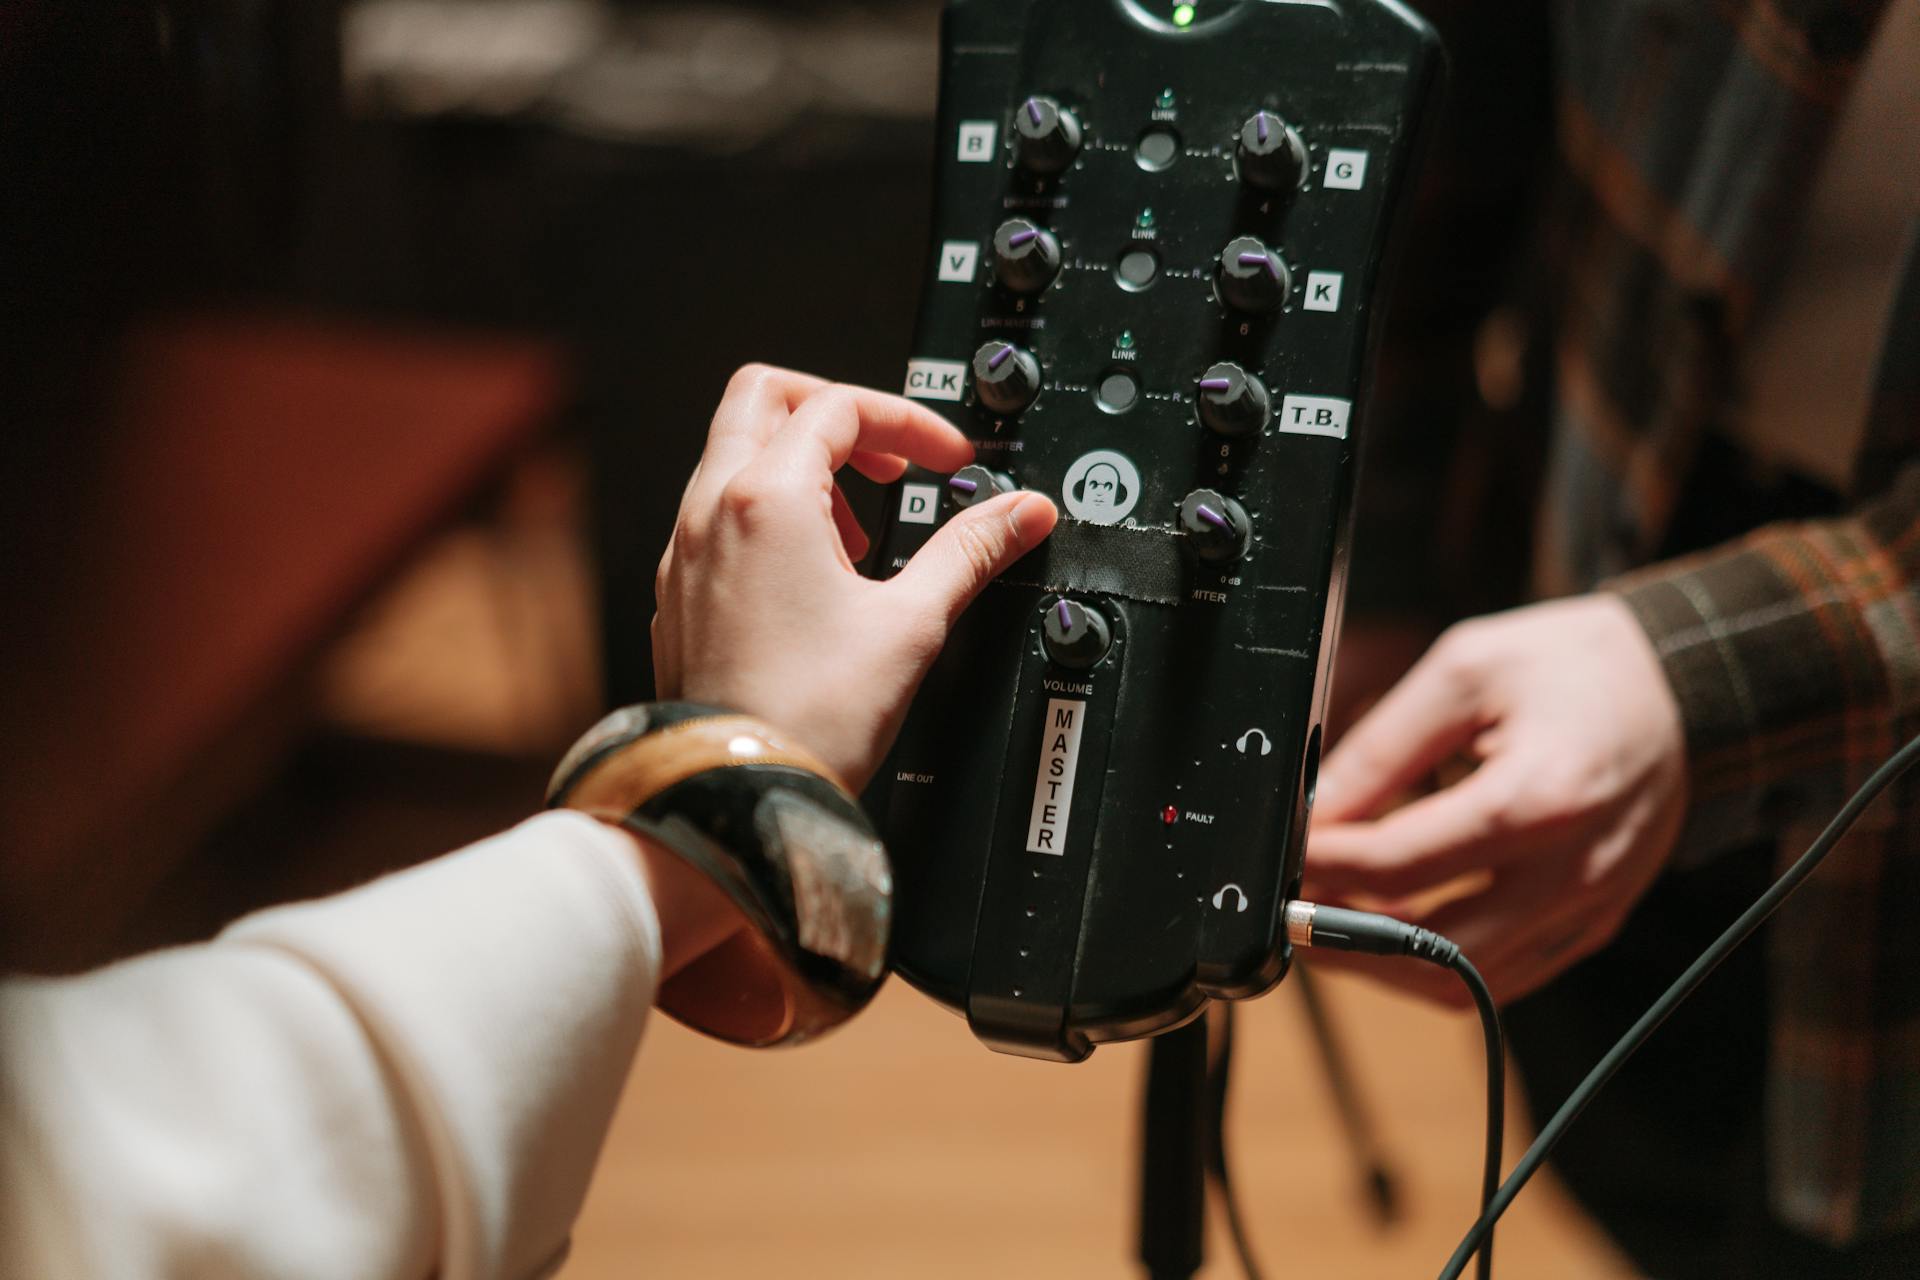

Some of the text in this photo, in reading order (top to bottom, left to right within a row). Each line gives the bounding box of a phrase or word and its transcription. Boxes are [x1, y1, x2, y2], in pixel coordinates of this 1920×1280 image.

[967, 138, 982, 152] B
[1334, 162, 1352, 179] G
[1132, 229, 1156, 240] LINK
[949, 256, 966, 271] V
[1192, 268, 1200, 278] R
[1314, 284, 1332, 302] K
[1112, 349, 1136, 360] LINK
[909, 370, 957, 391] CLK
[1172, 392, 1180, 402] R
[1291, 406, 1340, 428] T.B.
[994, 422, 1002, 432] 7
[1220, 445, 1230, 457] 8
[908, 496, 926, 513] D
[892, 558, 909, 568] AU
[1220, 576, 1241, 586] 0 dB
[1043, 680, 1092, 695] VOLUME
[897, 772, 935, 784] LINE OUT
[1038, 708, 1074, 848] MASTER
[1185, 812, 1214, 824] FAULT
